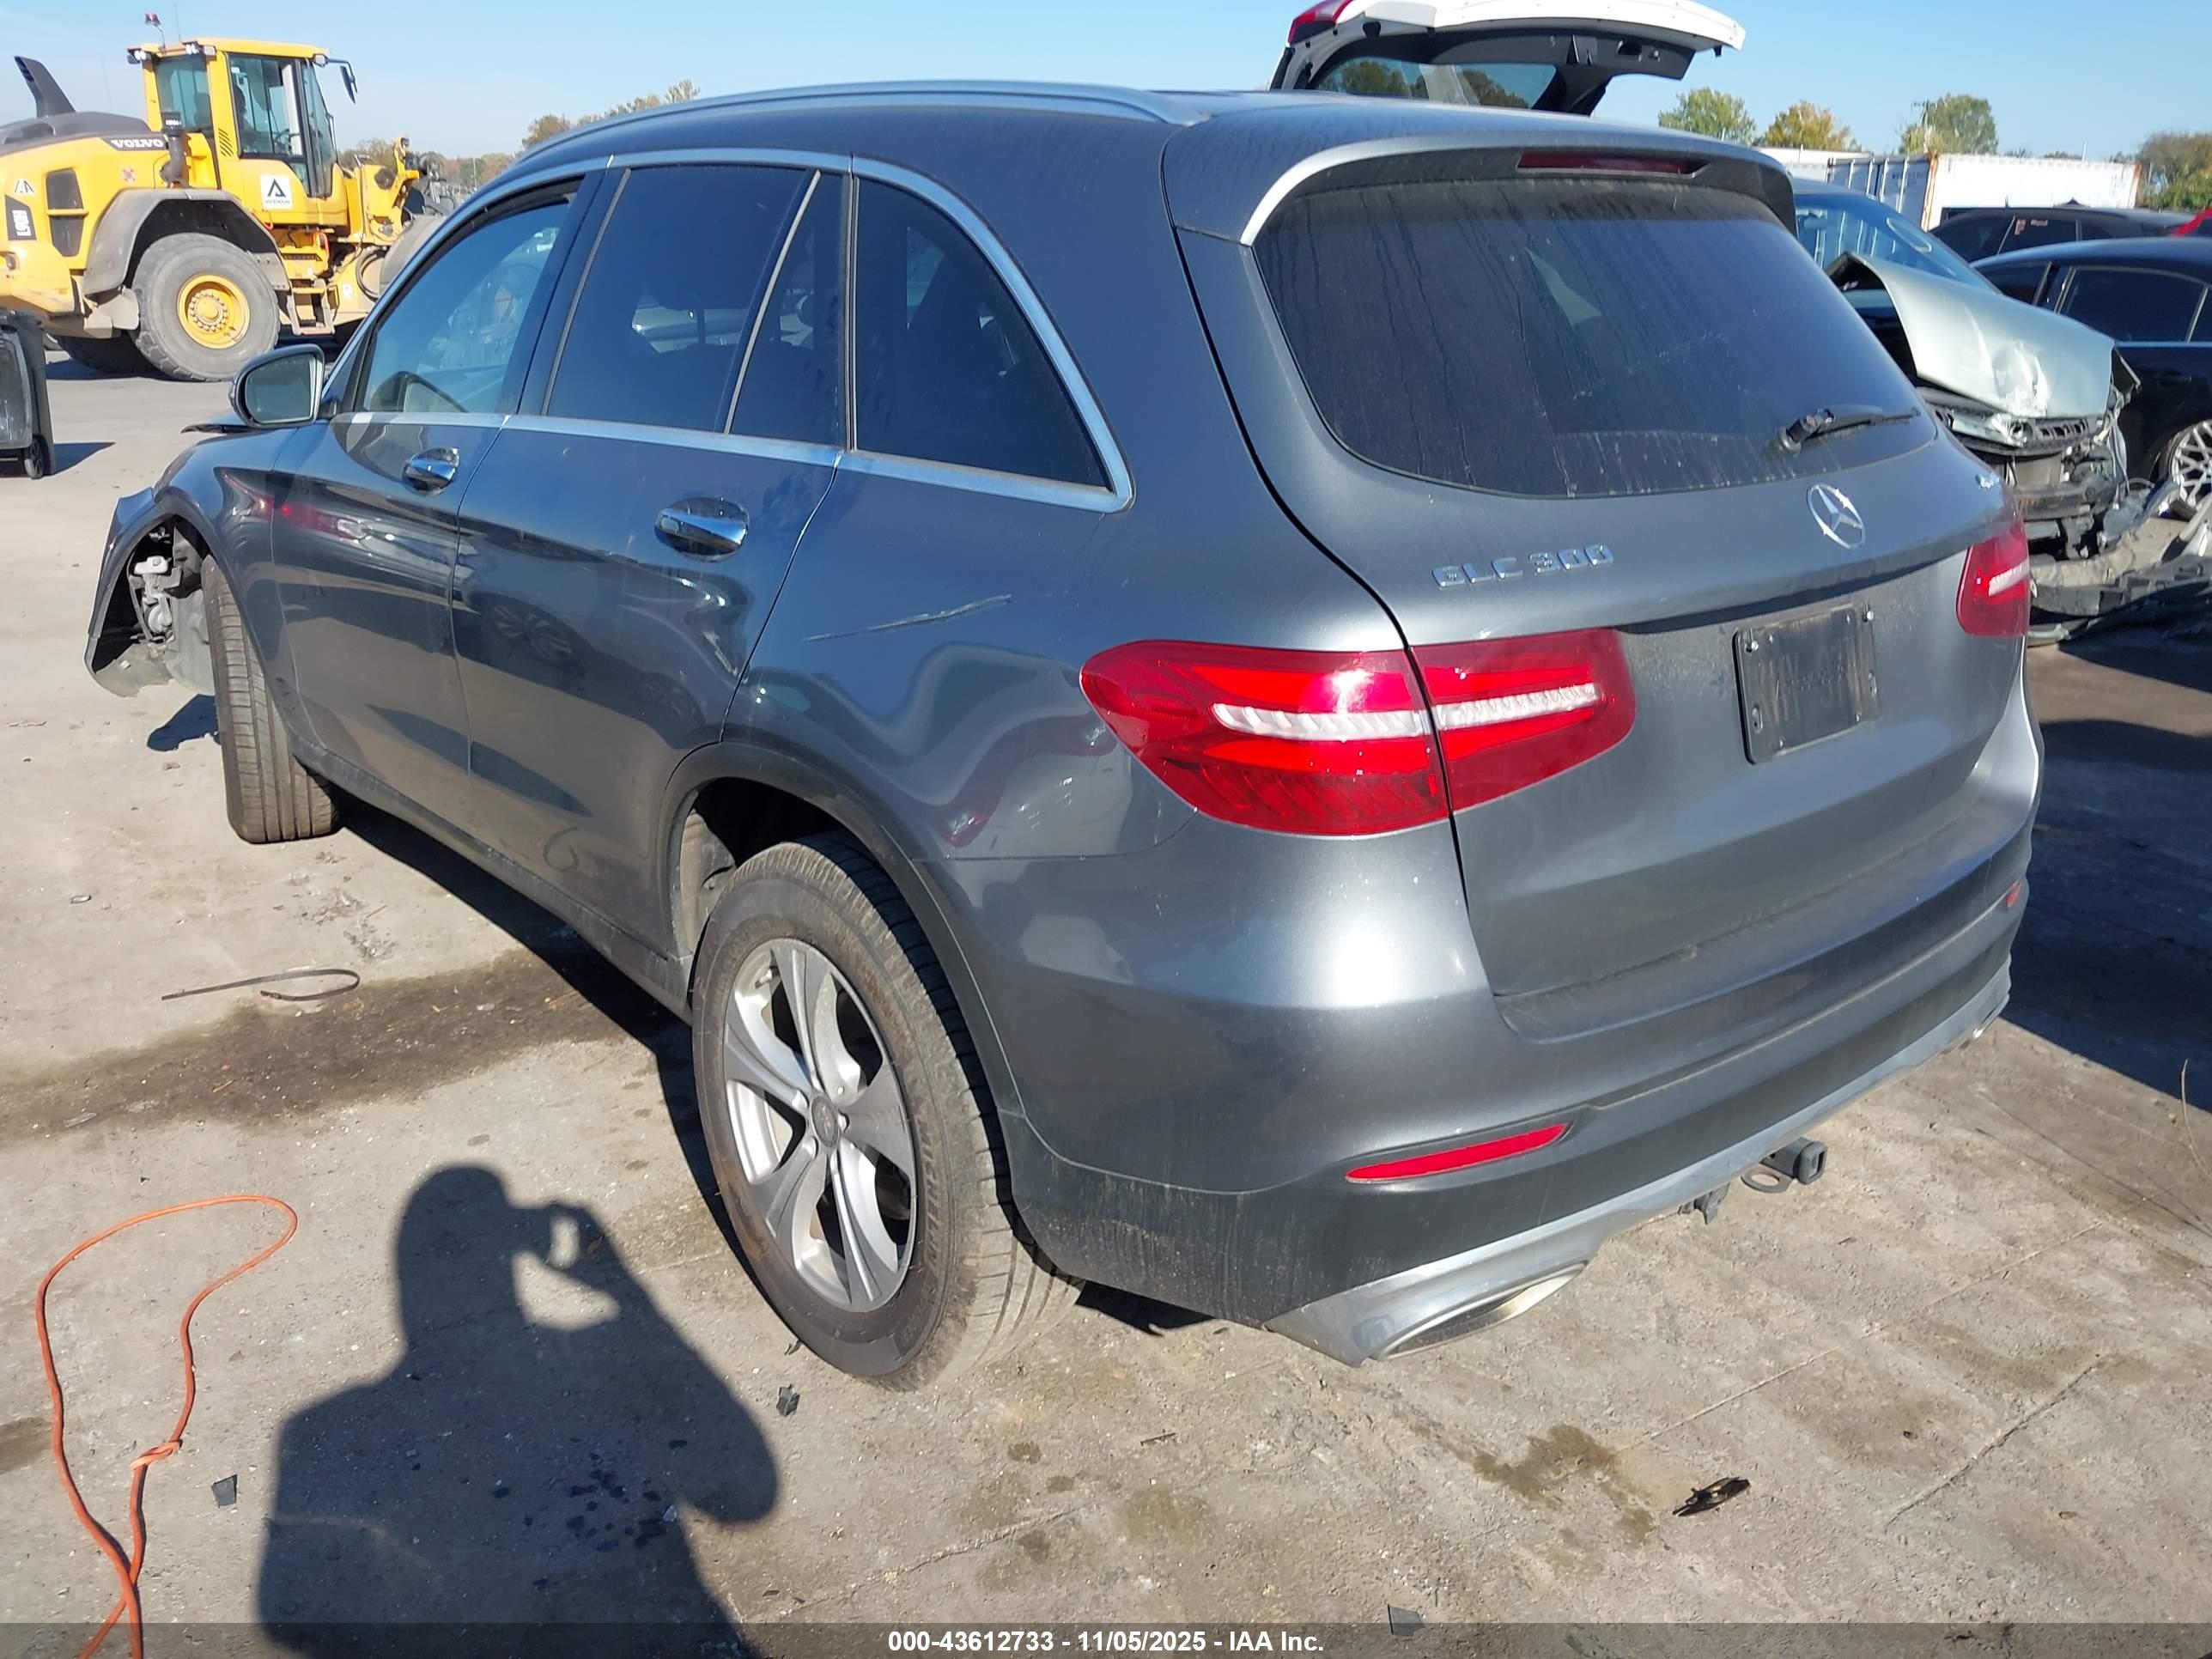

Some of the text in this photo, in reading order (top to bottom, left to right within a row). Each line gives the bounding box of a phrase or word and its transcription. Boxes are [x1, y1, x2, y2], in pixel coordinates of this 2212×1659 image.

[110, 139, 164, 148] VOLVO
[1431, 544, 1614, 588] GLC 300
